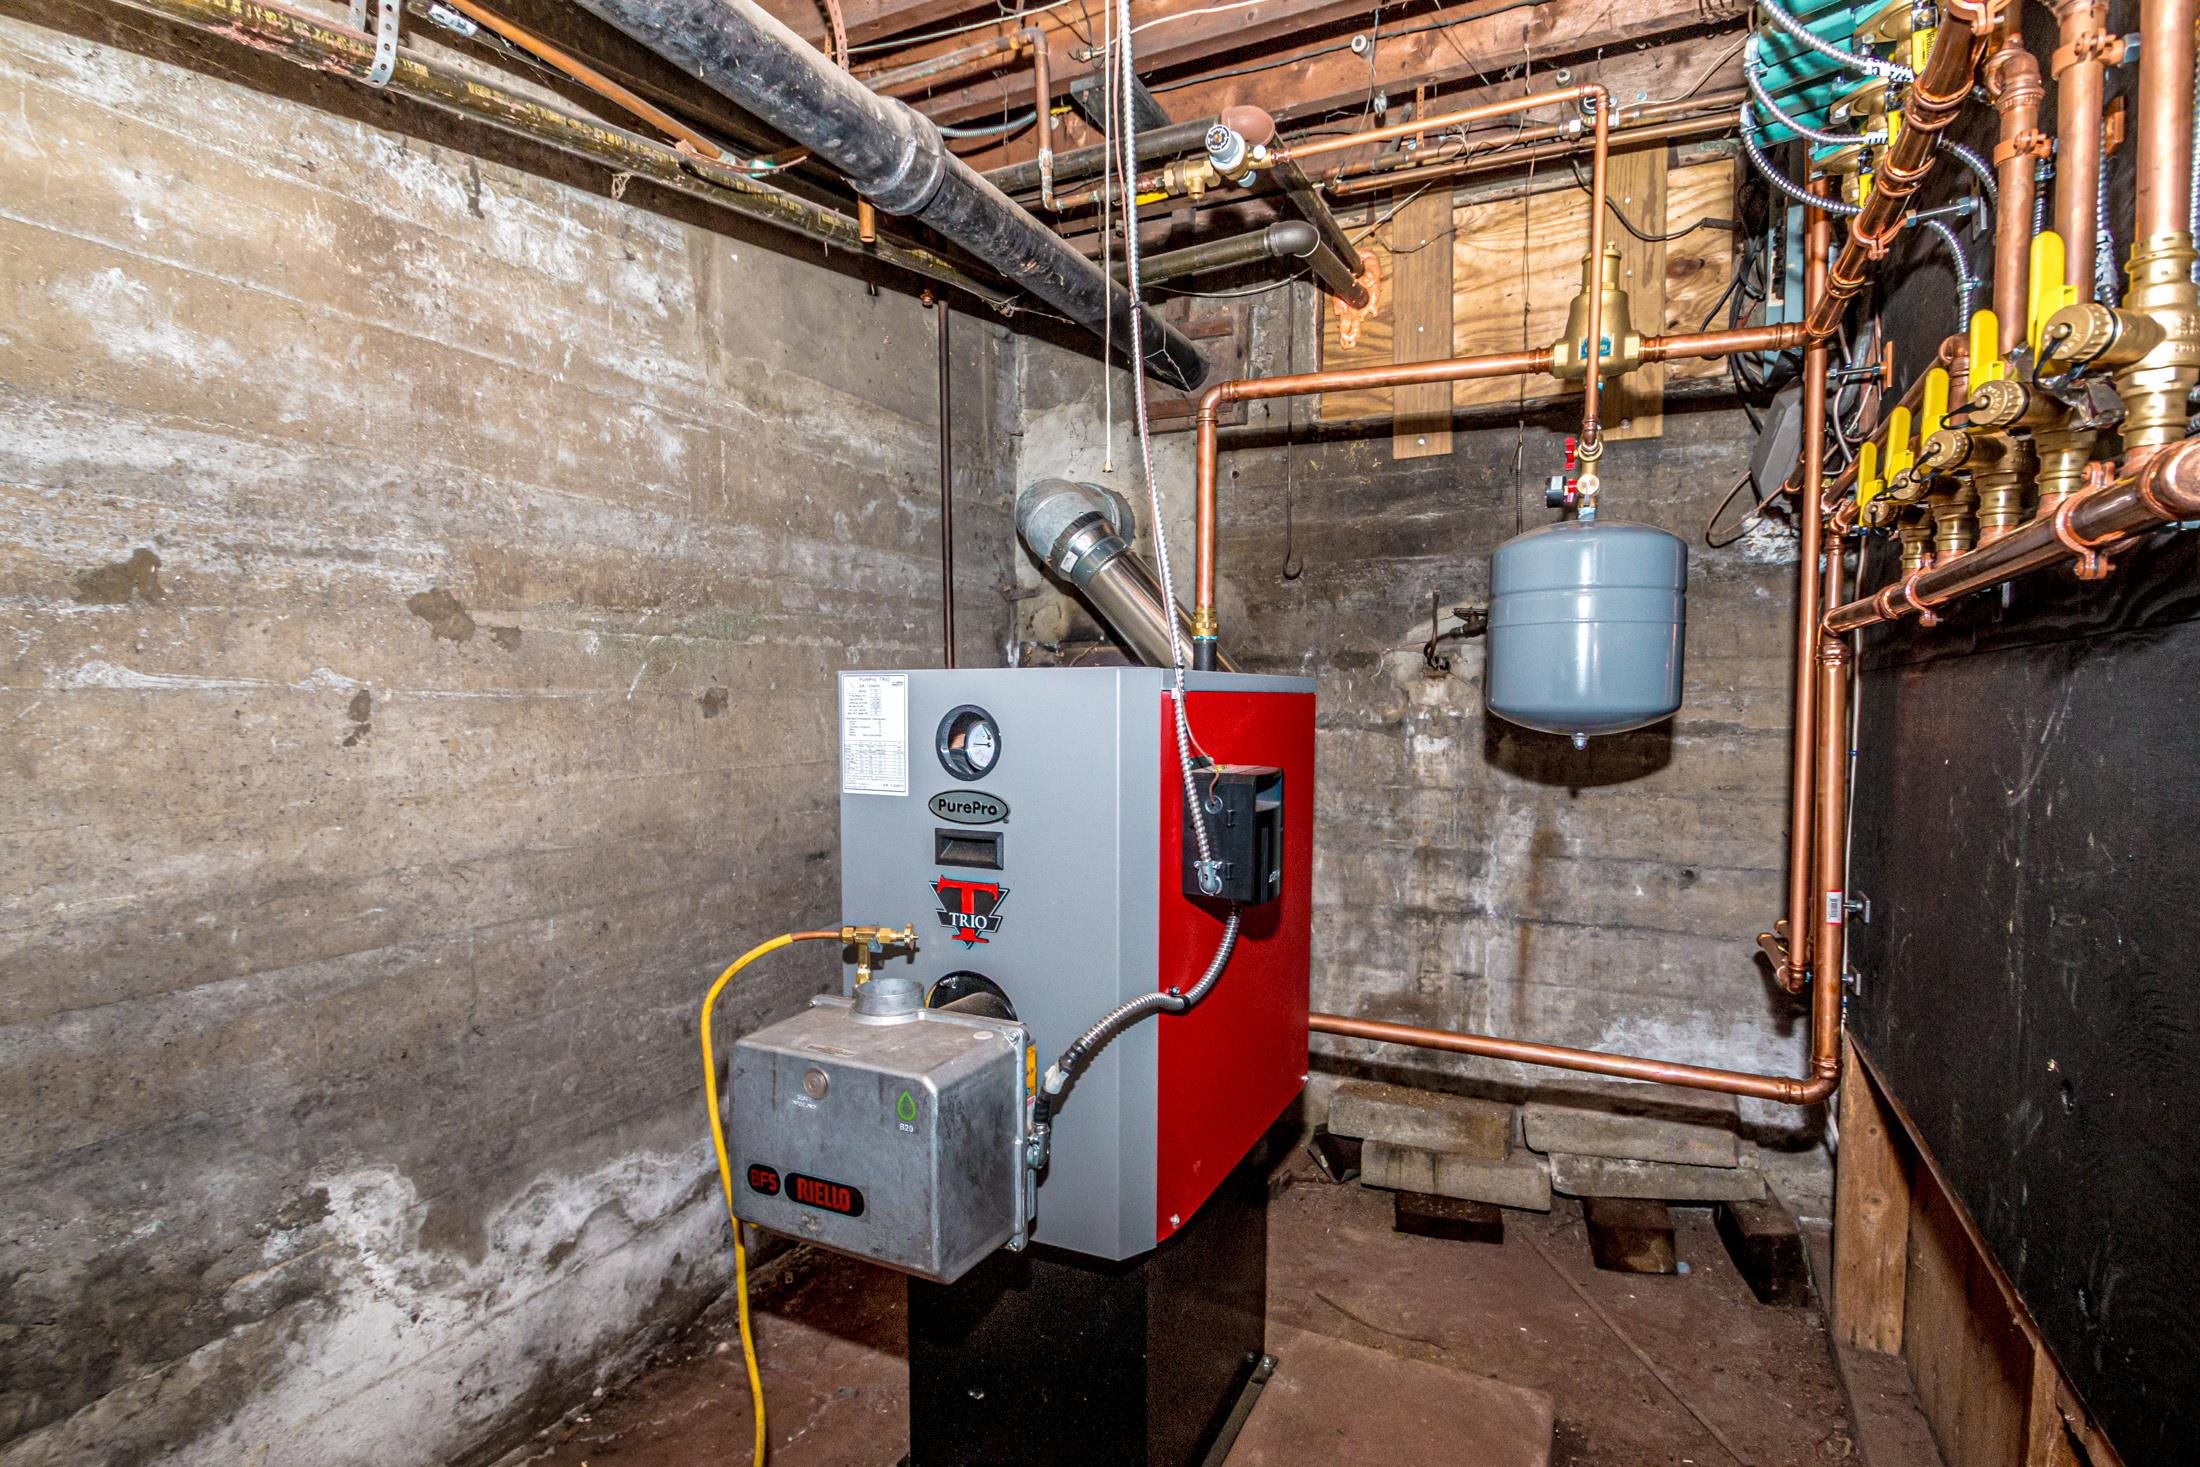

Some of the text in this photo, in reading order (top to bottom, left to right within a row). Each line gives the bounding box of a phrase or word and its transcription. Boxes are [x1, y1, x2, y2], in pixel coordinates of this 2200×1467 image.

[938, 798, 998, 817] PurePro
[949, 912, 988, 929] TRIO
[899, 1123, 914, 1133] B20
[796, 1177, 851, 1212] RIELLO
